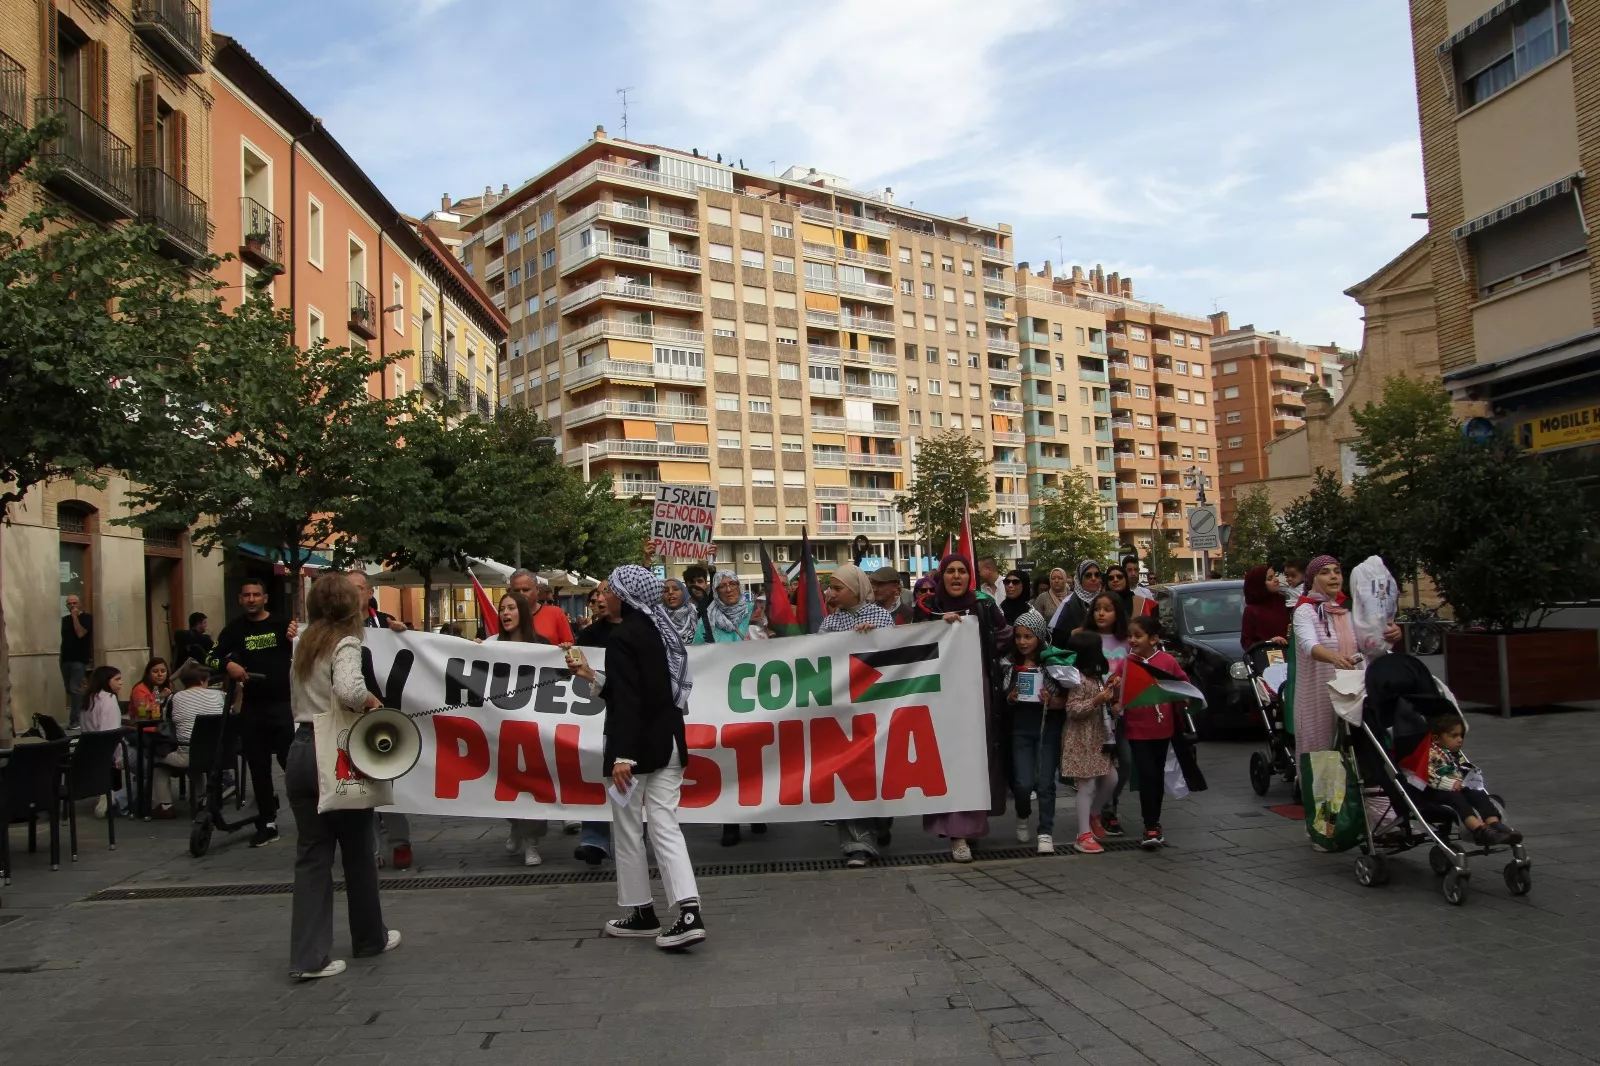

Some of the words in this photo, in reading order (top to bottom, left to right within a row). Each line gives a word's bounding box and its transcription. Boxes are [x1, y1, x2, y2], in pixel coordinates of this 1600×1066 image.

[1539, 409, 1590, 433] MOBILE
[657, 486, 715, 508] ISRAEL
[655, 502, 713, 525] GENOCIDA
[654, 520, 702, 543] EUROPA
[653, 538, 709, 560] PATROCINA
[727, 656, 833, 714] CON
[433, 704, 948, 808] PALSTINA
